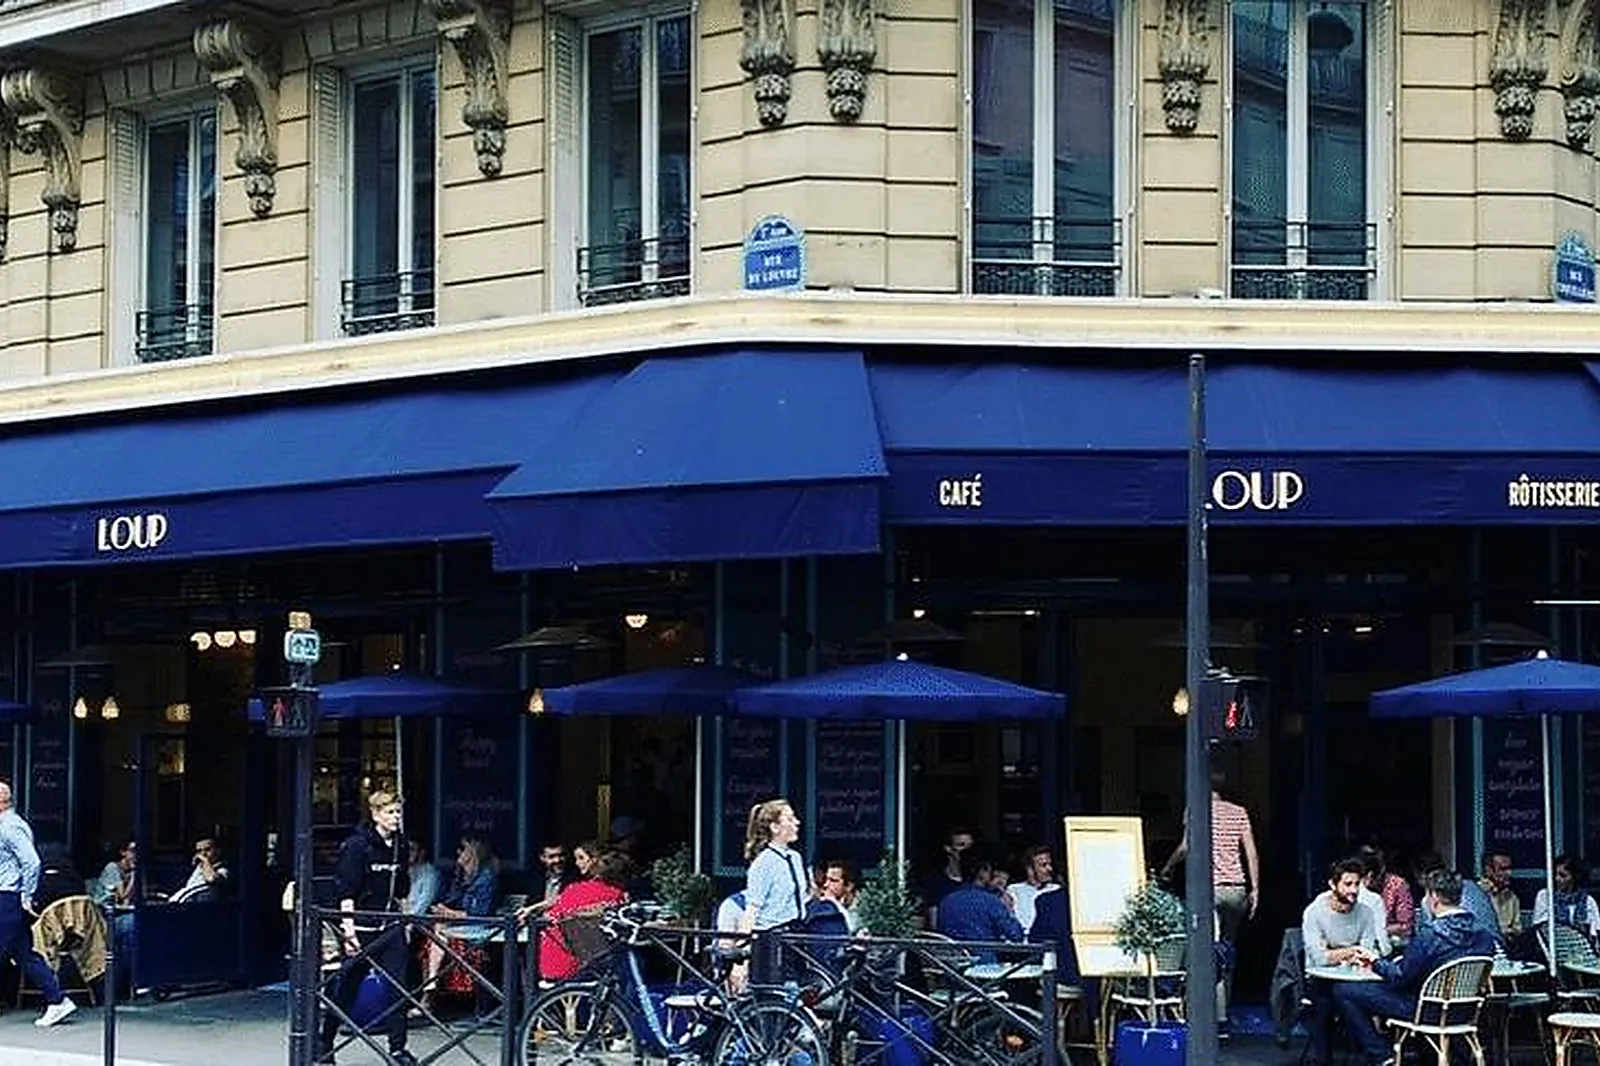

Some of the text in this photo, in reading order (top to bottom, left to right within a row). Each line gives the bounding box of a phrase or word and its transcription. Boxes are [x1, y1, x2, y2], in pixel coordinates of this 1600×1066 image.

[940, 473, 982, 506] CAFÉ
[1204, 470, 1303, 510] OUP
[1508, 473, 1600, 507] RÔTISSERIE
[98, 514, 168, 551] LOUP
